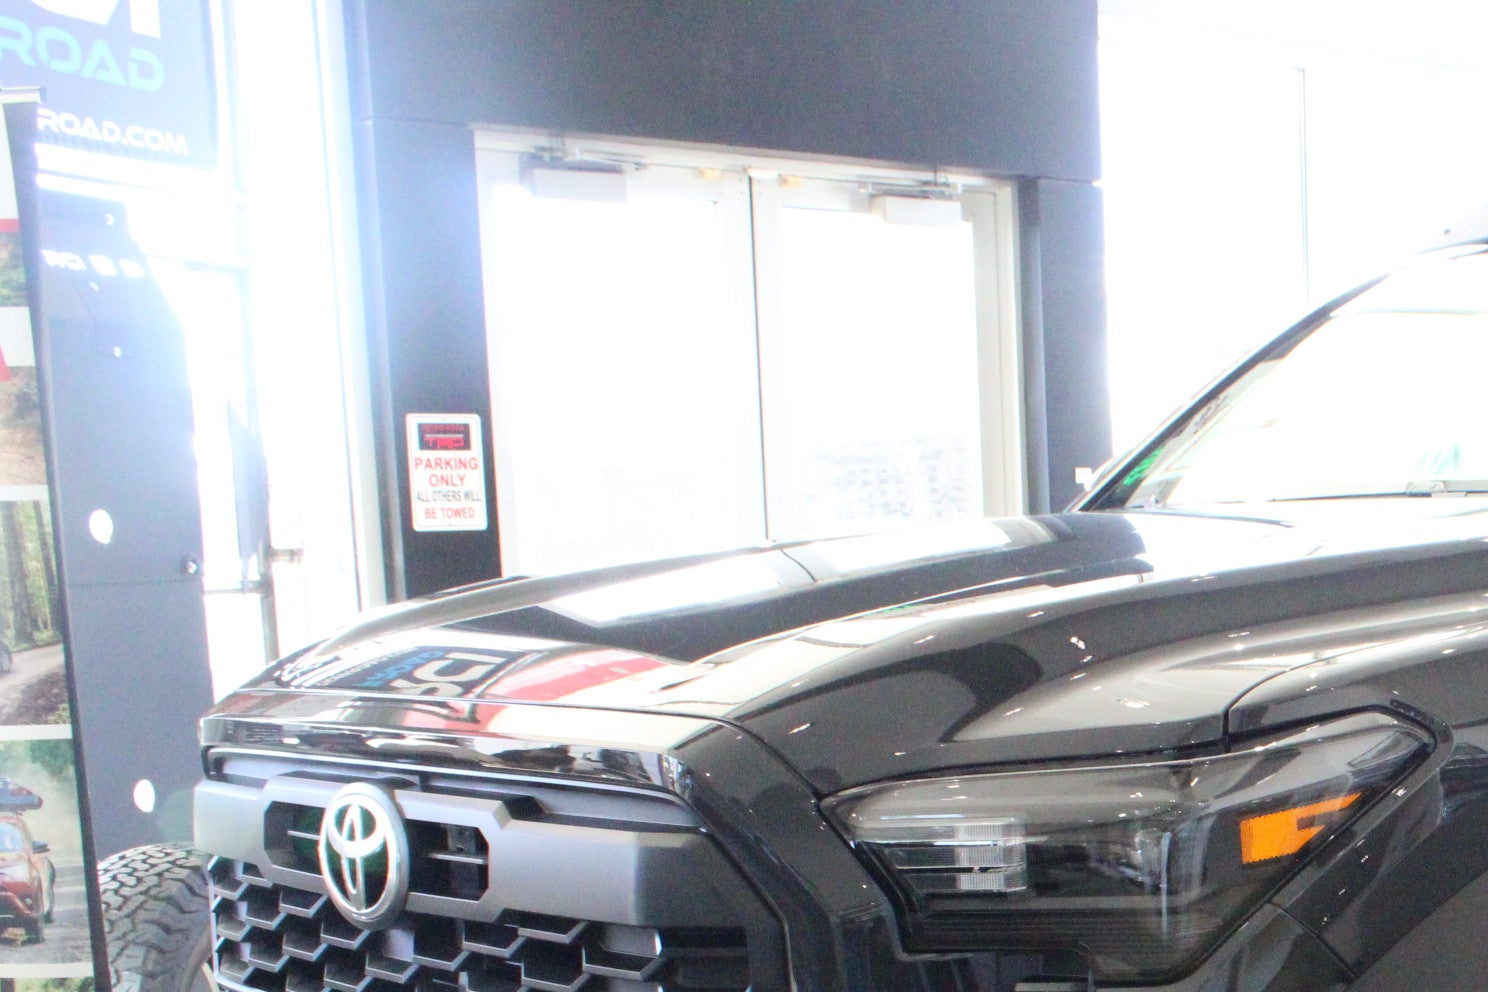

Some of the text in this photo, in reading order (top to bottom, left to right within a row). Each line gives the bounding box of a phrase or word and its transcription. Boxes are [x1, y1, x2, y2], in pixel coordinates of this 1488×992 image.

[414, 457, 479, 470] PARKING
[428, 473, 466, 487] ONLY
[416, 489, 482, 502] ALL OTHERS WILL
[424, 507, 475, 519] BE TOWED
